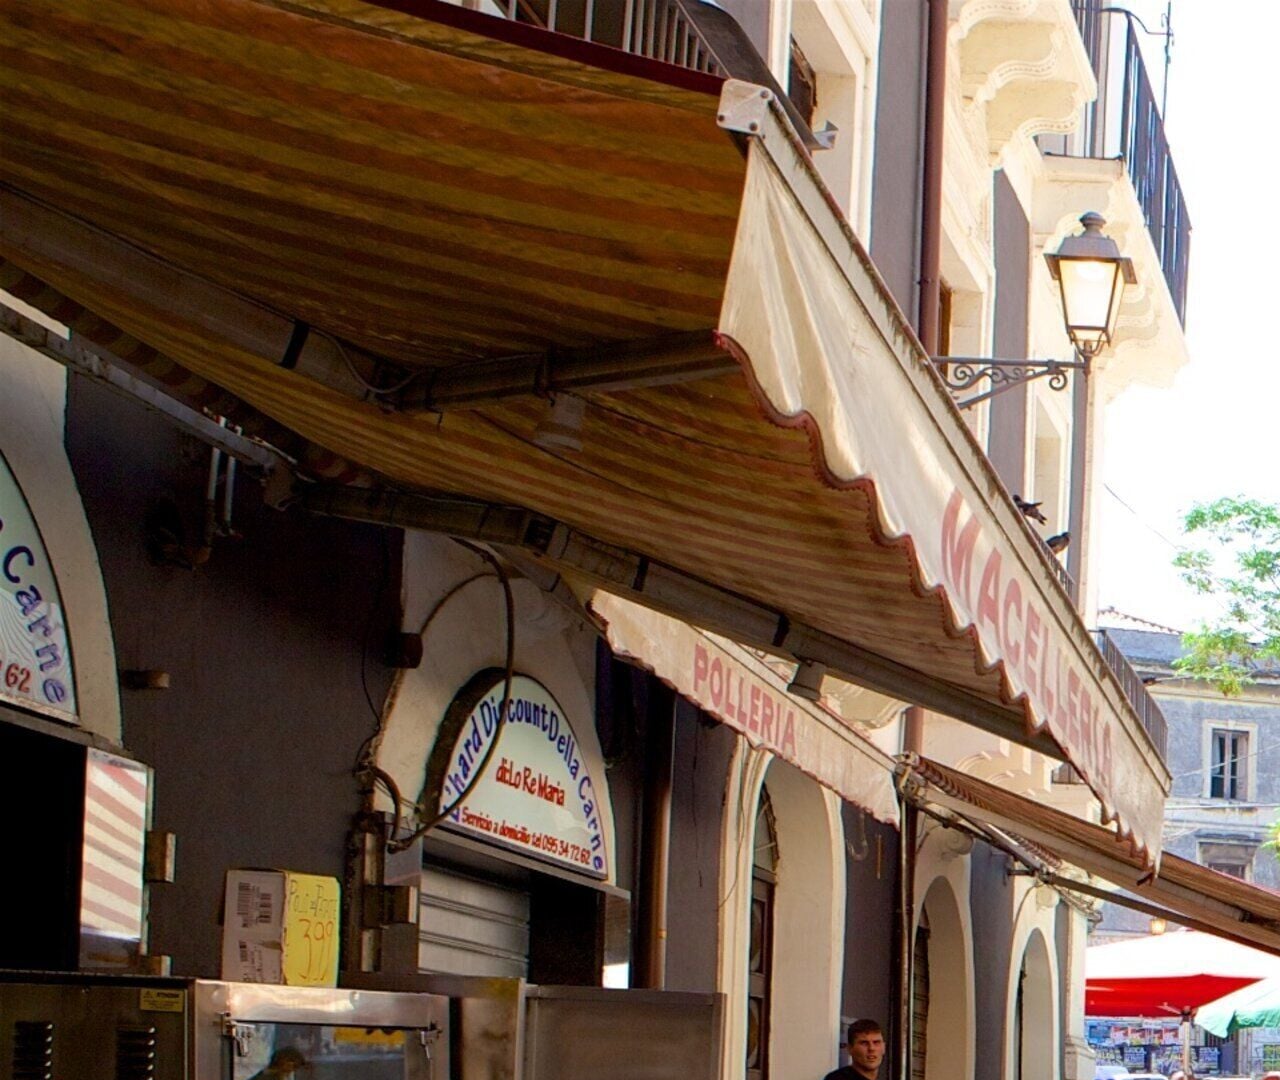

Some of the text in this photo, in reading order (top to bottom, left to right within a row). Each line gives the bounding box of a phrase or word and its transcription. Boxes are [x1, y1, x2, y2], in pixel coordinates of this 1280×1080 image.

[3, 545, 67, 704] Carne
[693, 642, 797, 757] POLLERIA
[940, 486, 1113, 797] MACELLERIA
[538, 772, 565, 806] Maria
[548, 711, 580, 780] Della
[578, 775, 603, 870] Carne
